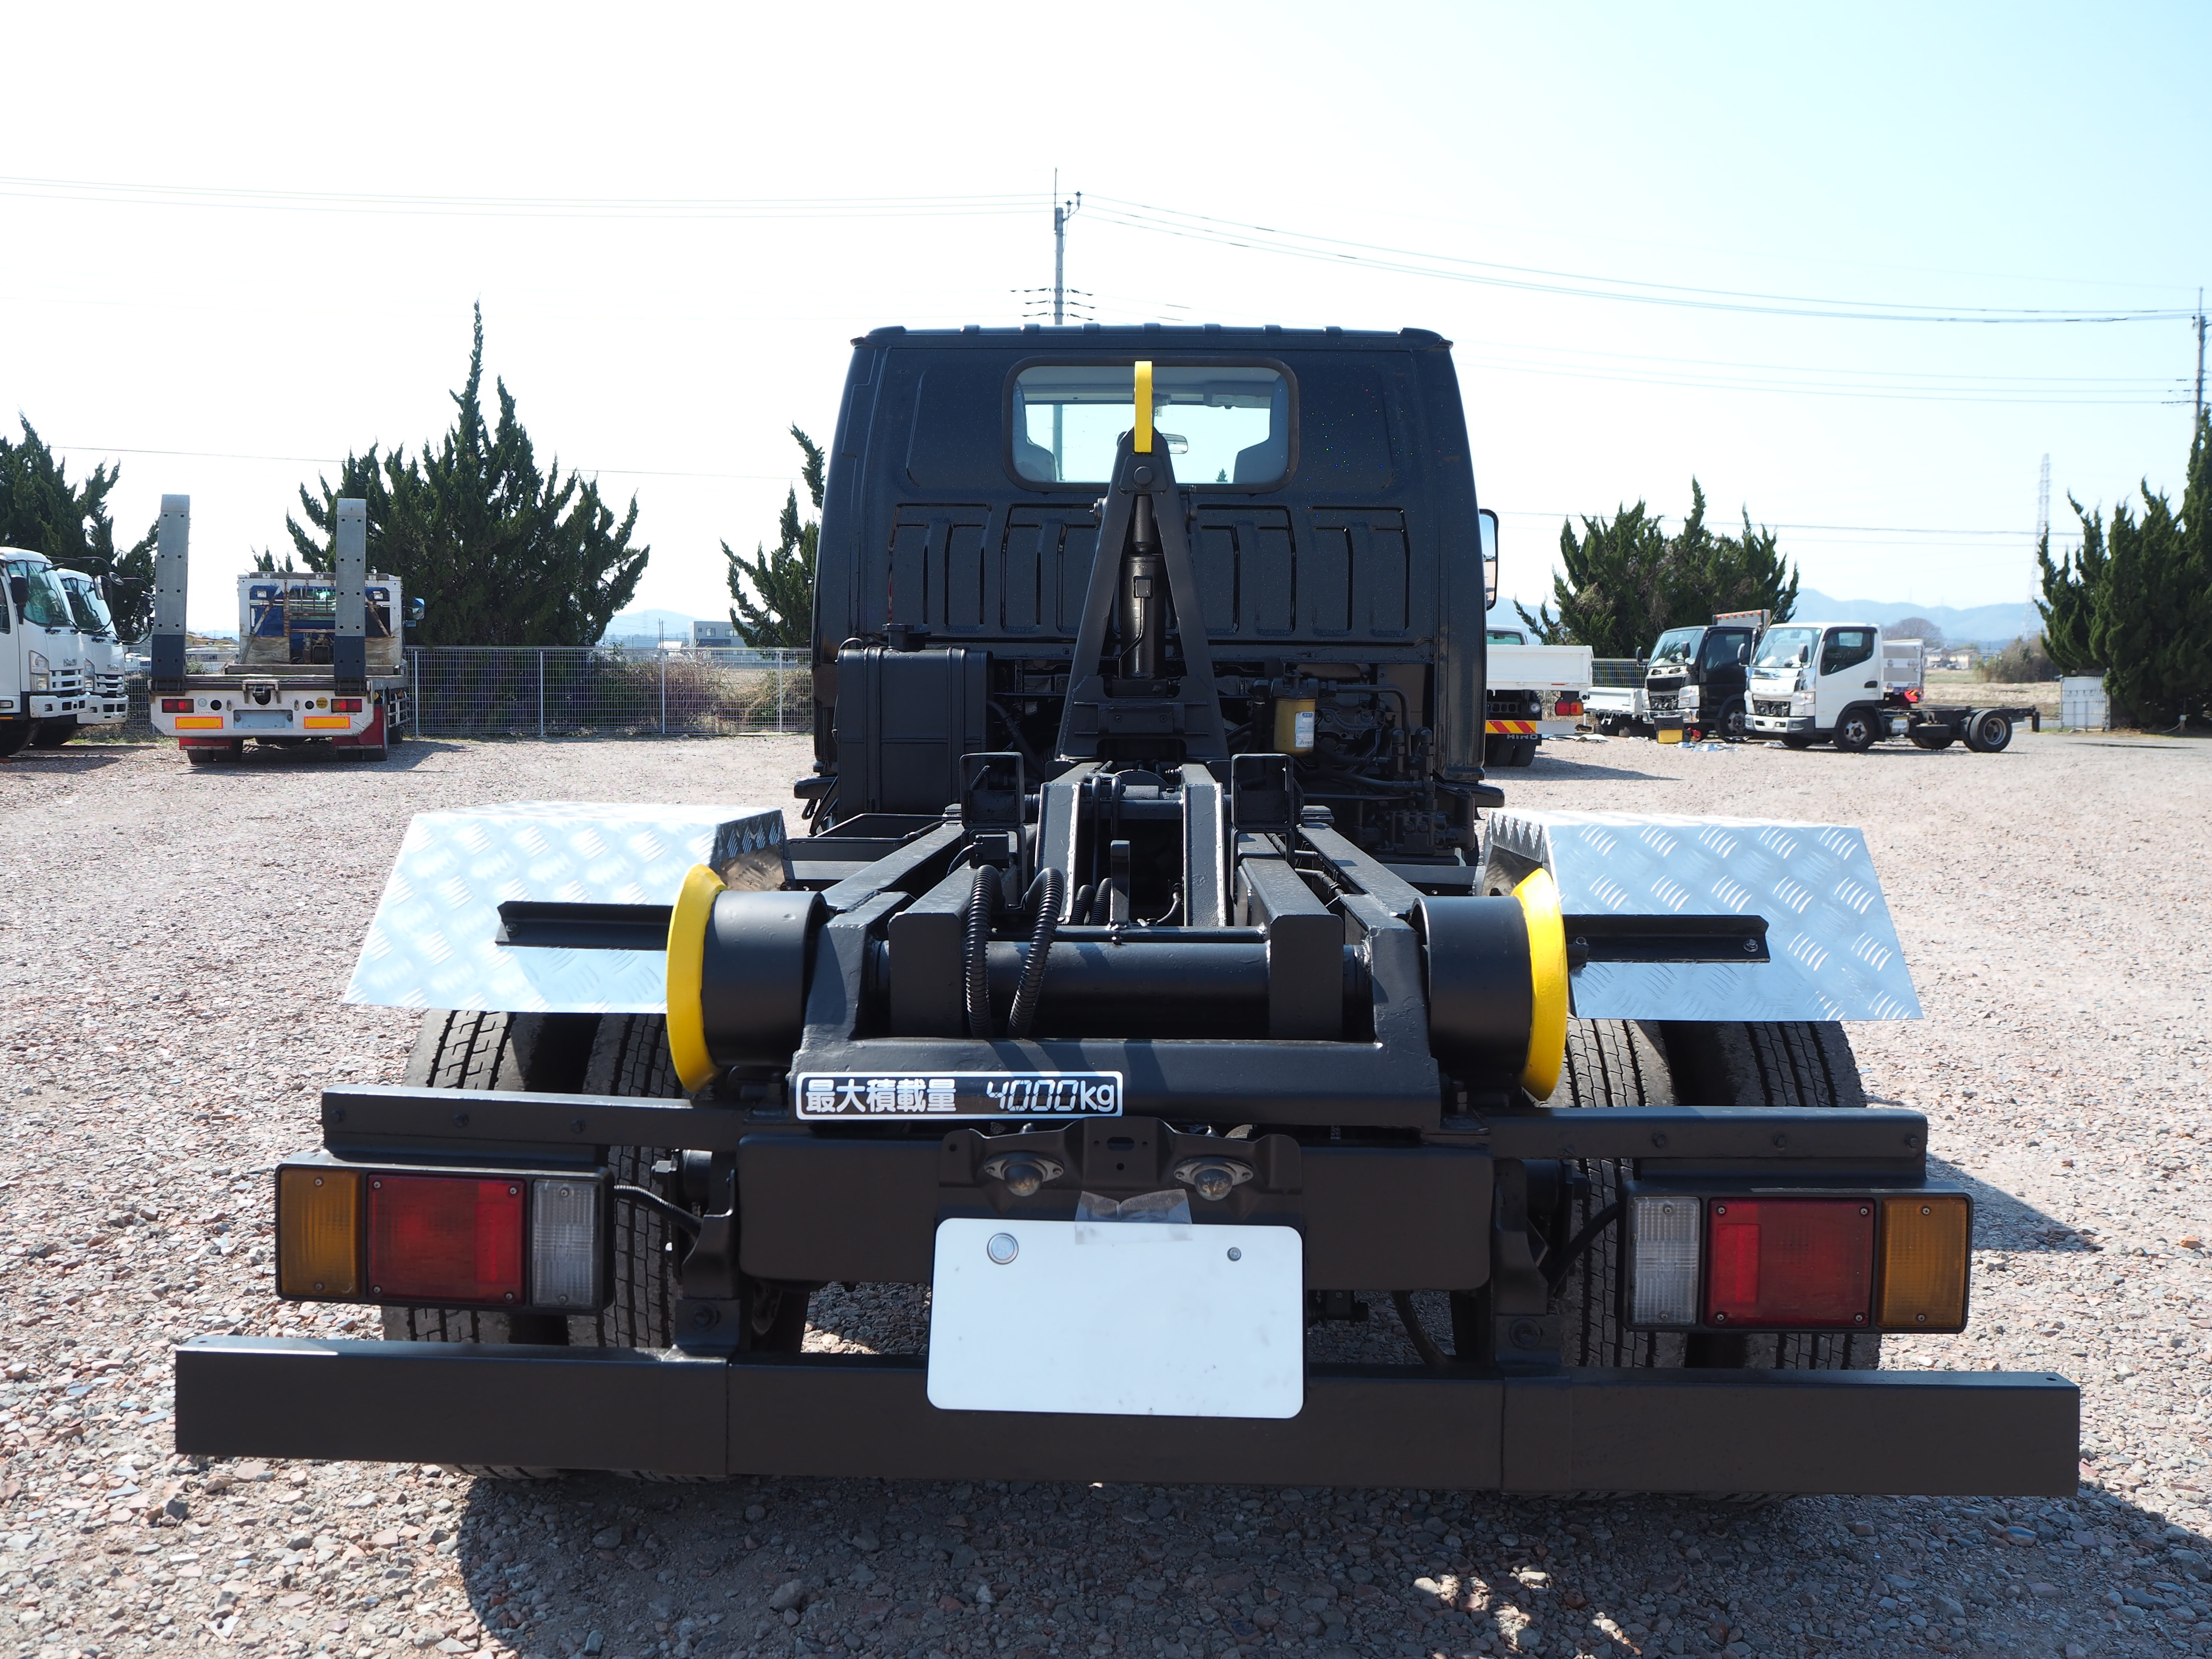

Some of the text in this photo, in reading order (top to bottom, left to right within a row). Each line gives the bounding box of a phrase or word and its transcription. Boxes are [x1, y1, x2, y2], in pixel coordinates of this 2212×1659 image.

[806, 1078, 1114, 1112] 最大積載量 4000kg
